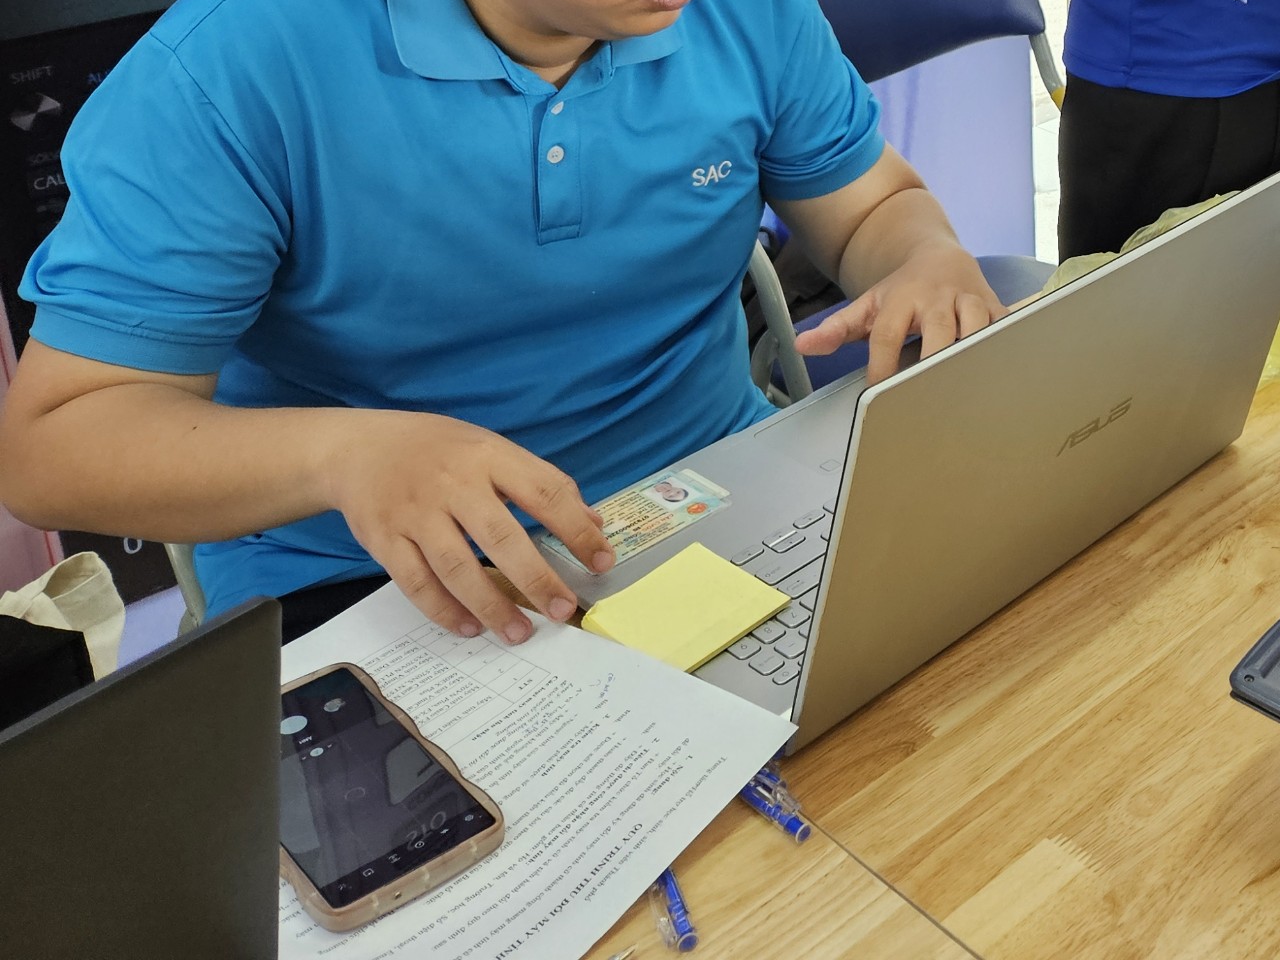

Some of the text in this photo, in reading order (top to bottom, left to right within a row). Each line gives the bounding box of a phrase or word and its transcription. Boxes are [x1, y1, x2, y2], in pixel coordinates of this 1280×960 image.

[11, 65, 53, 84] SHIFT
[692, 160, 732, 186] SAC
[1056, 397, 1132, 457] ASUS
[541, 833, 560, 851] máy
[631, 835, 648, 851] sinh
[616, 849, 634, 867] viên
[595, 866, 619, 889] Thành
[493, 821, 644, 960] QUY TRÌNH THU ĐỔI MÁY TÍNH
